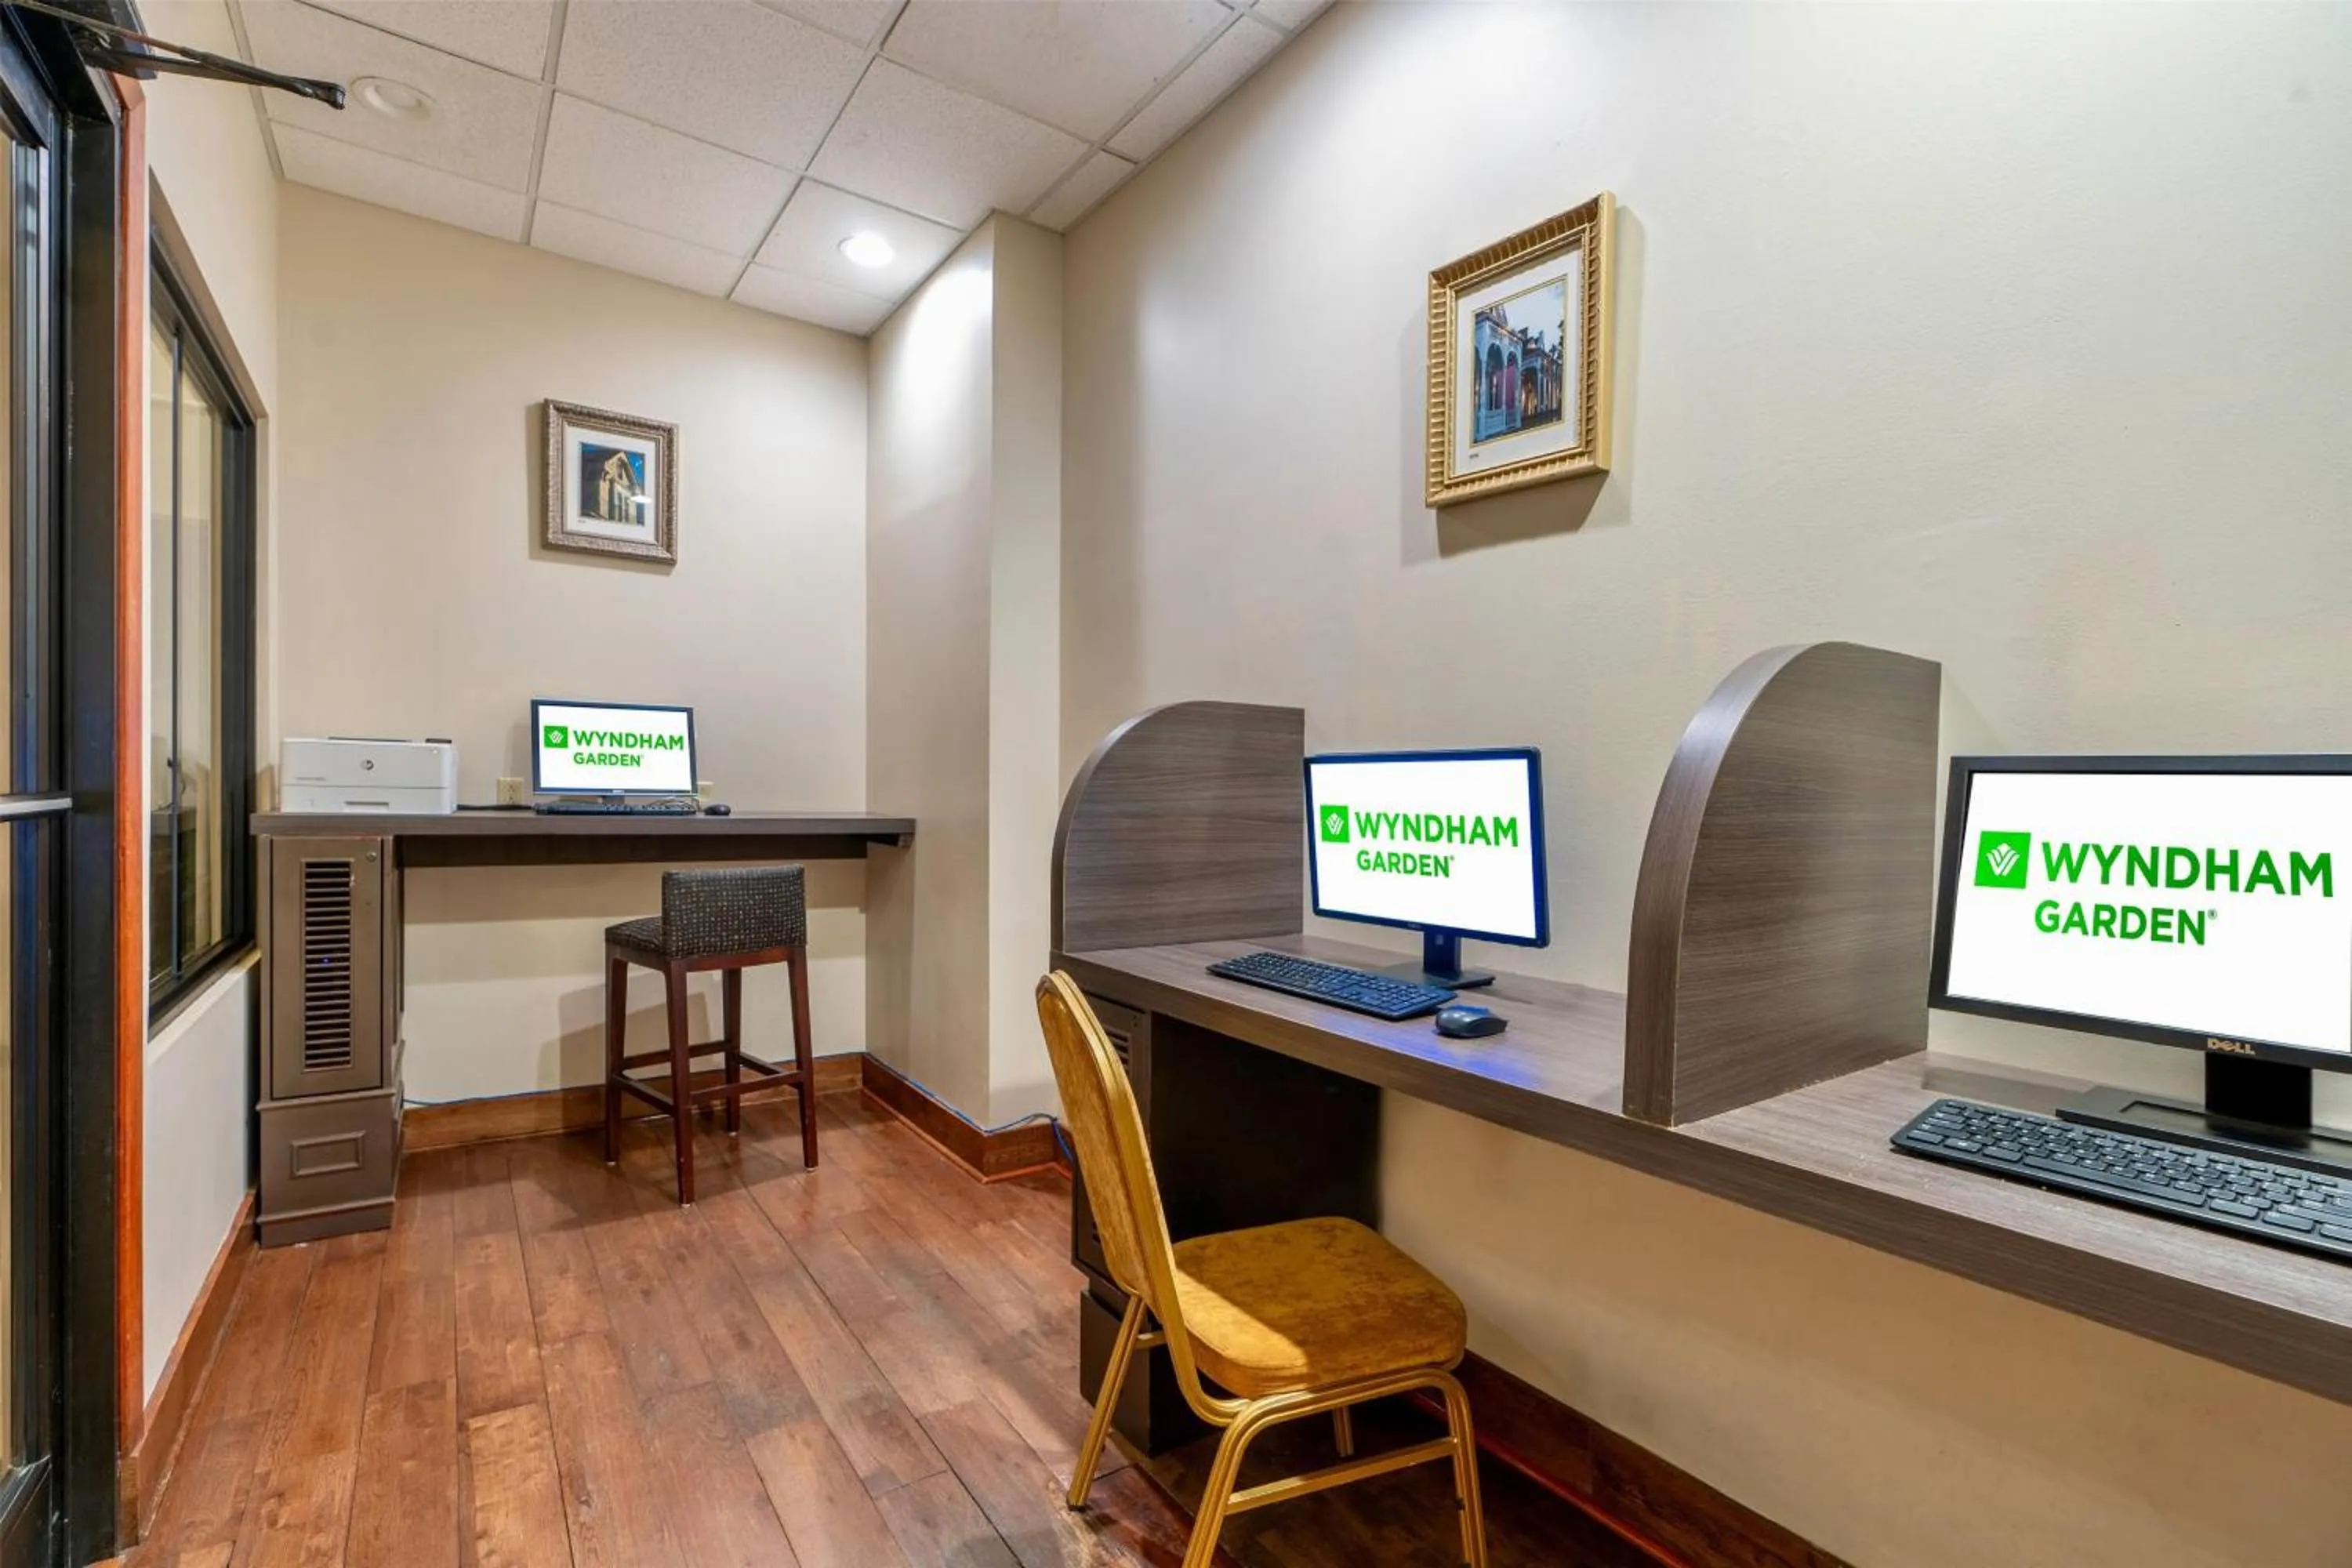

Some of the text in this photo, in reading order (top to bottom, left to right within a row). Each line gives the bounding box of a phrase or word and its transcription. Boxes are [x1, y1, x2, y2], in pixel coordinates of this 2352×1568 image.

[573, 730, 684, 750] WYNDHAM
[573, 752, 641, 767] GARDEN
[1354, 811, 1519, 848] WYNDHAM
[2042, 840, 2334, 898] WYNDHAM
[2207, 1037, 2256, 1055] DELL
